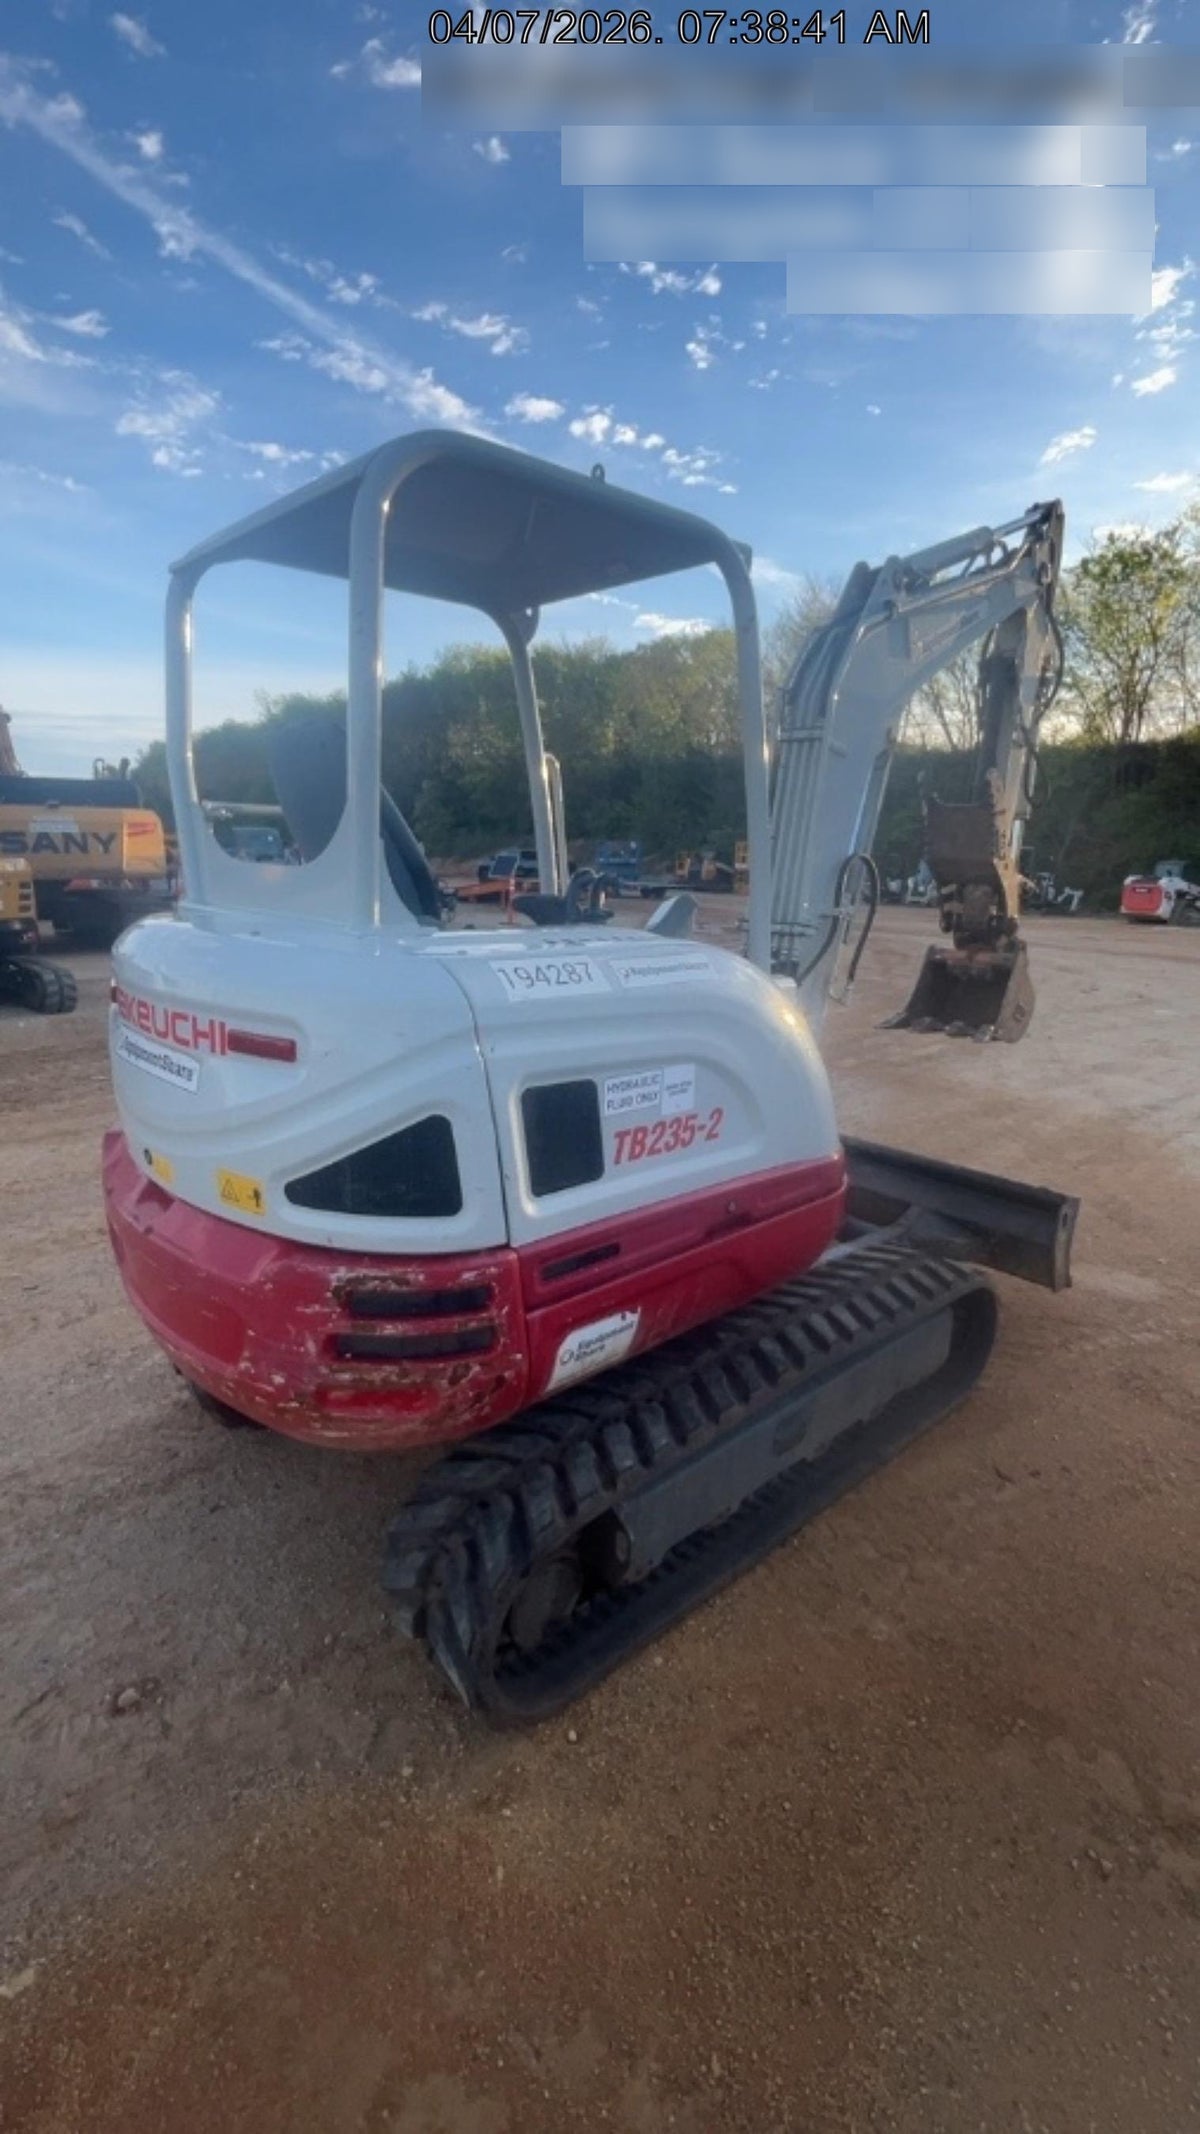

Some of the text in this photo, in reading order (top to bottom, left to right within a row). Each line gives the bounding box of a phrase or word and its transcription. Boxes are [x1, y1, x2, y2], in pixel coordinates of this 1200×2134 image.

[0, 831, 117, 854] SANY
[498, 961, 594, 990] 194287
[606, 1092, 658, 1111] FLUID ONLY
[613, 1106, 724, 1165] TB235-2
